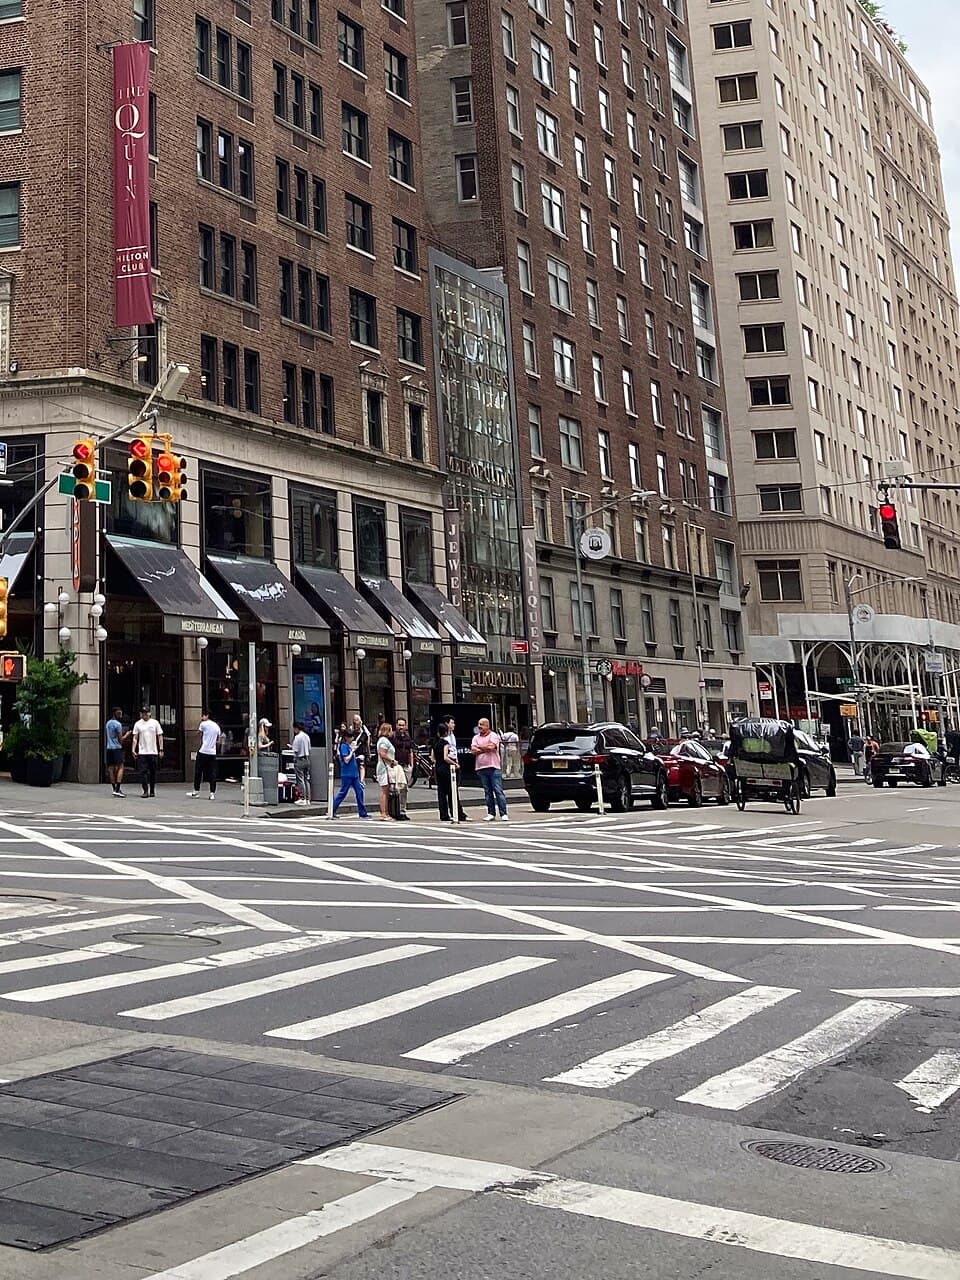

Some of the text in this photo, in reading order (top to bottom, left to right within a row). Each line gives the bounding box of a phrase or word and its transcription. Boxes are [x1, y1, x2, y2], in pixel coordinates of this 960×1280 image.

[118, 85, 145, 99] THE
[115, 103, 146, 202] QUIN
[116, 251, 149, 262] HILTON
[121, 262, 144, 272] CLUB
[524, 536, 540, 653] ANTIQUES
